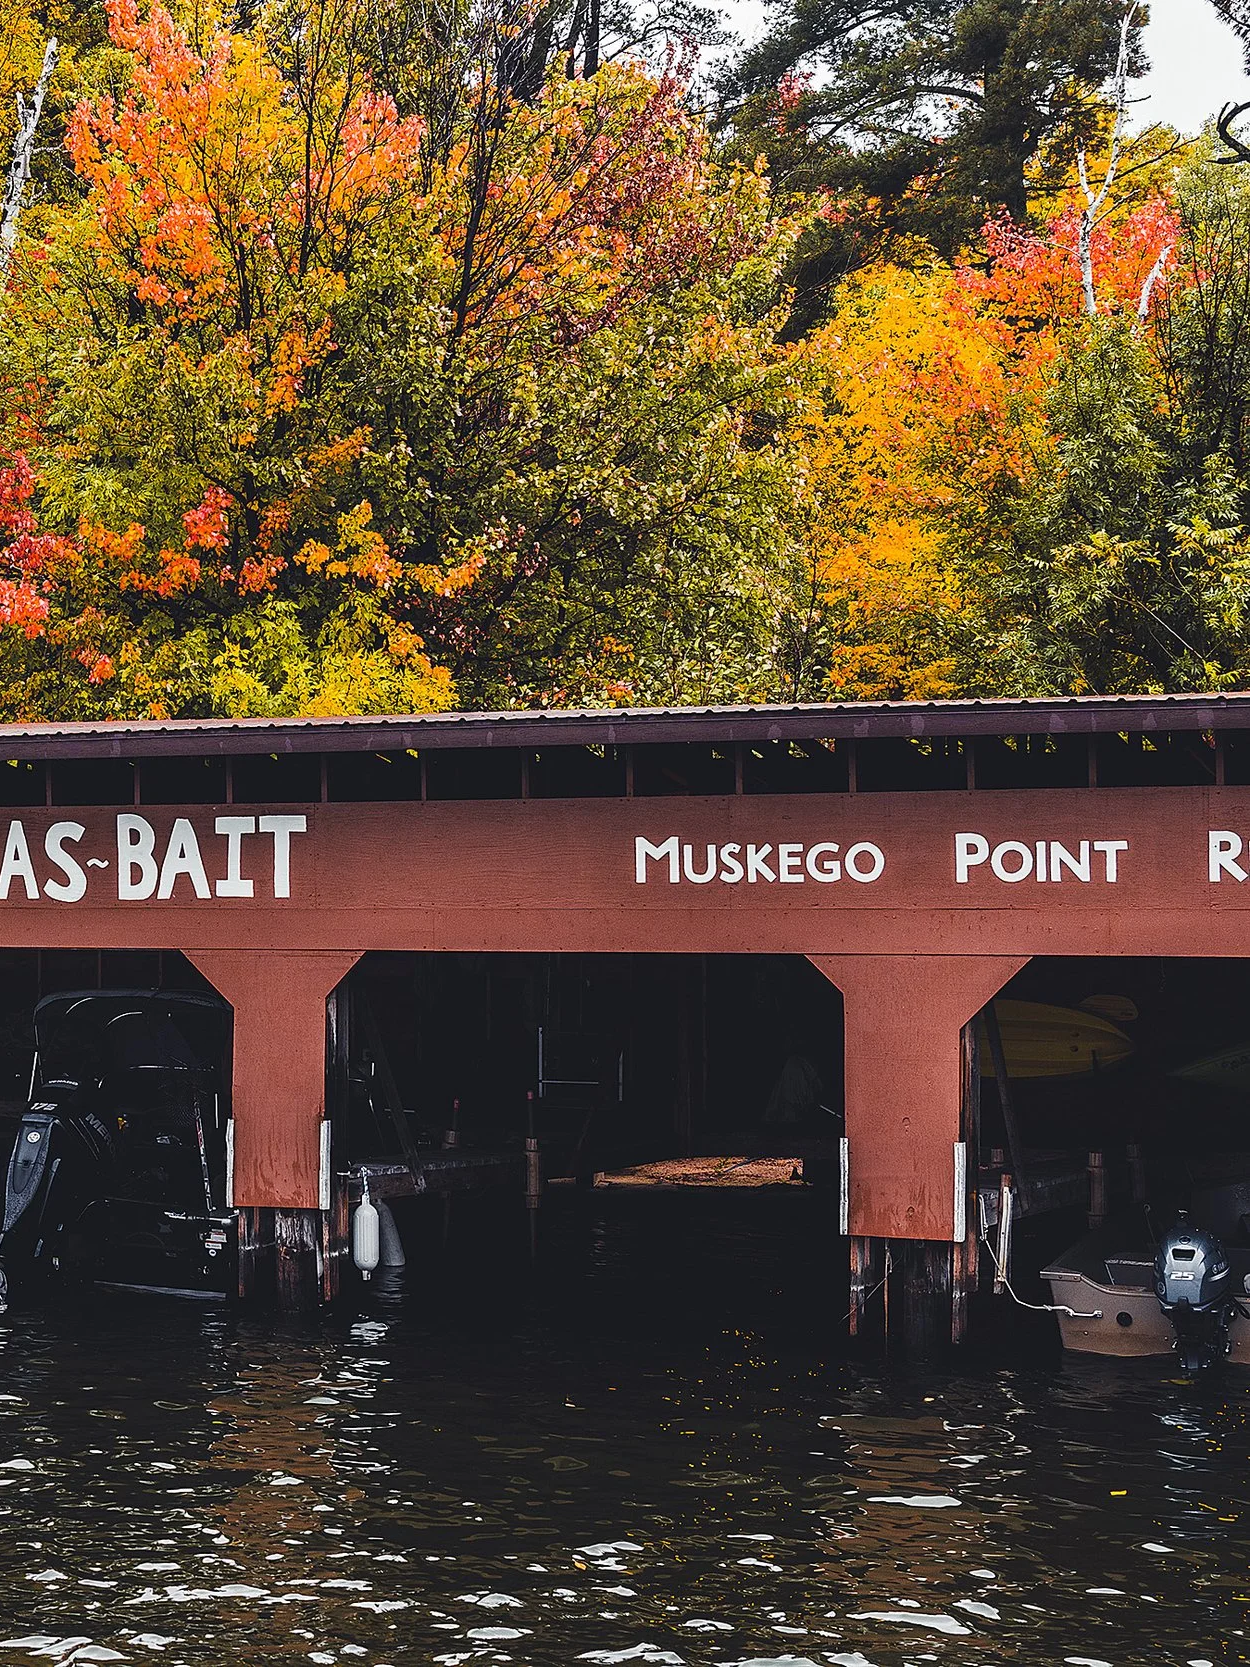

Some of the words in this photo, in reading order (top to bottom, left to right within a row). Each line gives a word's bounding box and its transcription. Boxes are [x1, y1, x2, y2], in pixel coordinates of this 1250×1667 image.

[635, 836, 885, 884] MUSKEGO
[955, 832, 1129, 883] POINT
[1208, 830, 1250, 883] R
[30, 1102, 58, 1111] 175
[1170, 1271, 1196, 1281] 25
